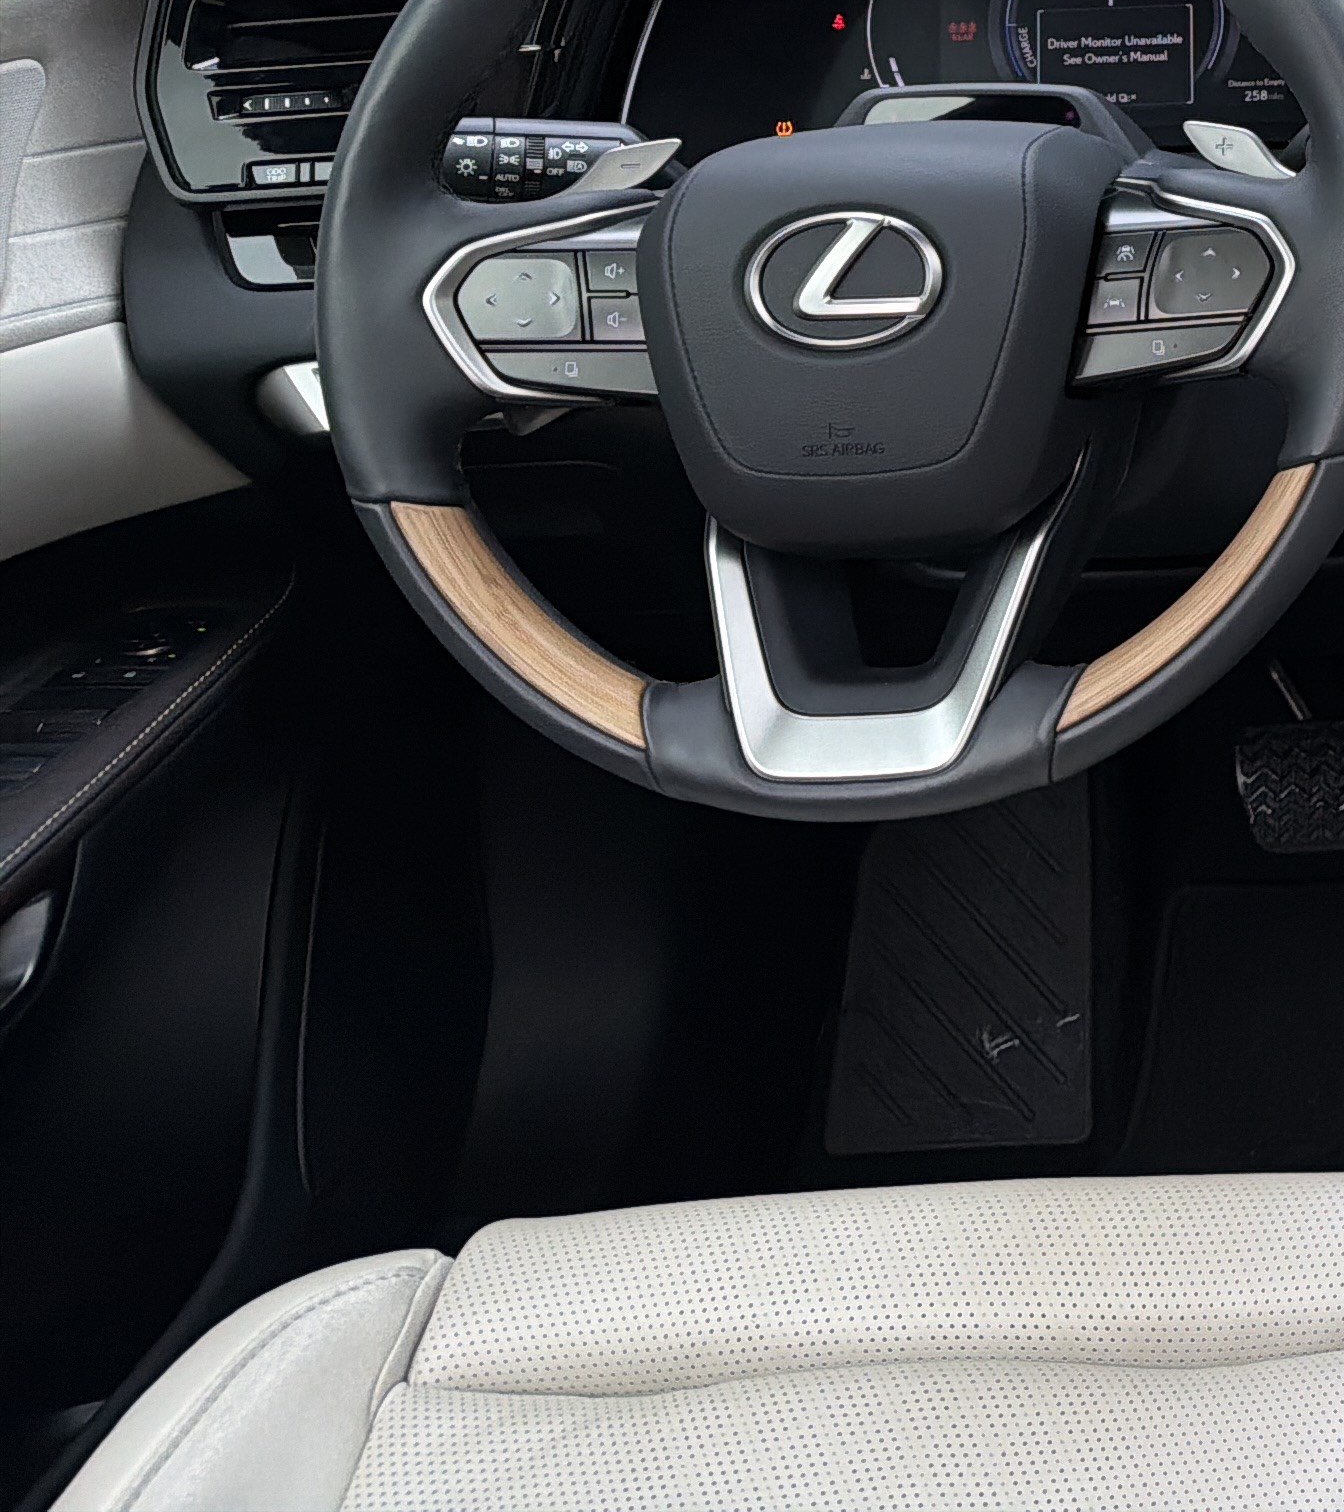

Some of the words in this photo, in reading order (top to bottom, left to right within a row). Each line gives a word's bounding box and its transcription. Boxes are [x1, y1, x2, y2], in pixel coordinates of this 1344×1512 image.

[1018, 26, 1036, 68] CHARGE
[1047, 37, 1078, 49] Driver
[1081, 36, 1122, 48] Monitor
[1124, 33, 1183, 46] Unavailable
[1063, 53, 1082, 65] See
[1084, 51, 1128, 64] Owner's
[1129, 50, 1168, 62] Manual
[1244, 89, 1268, 102] 258
[495, 173, 520, 182] AUTO
[546, 167, 566, 176] OFF
[802, 443, 828, 457] SRS
[832, 441, 885, 457] AIRBAG
